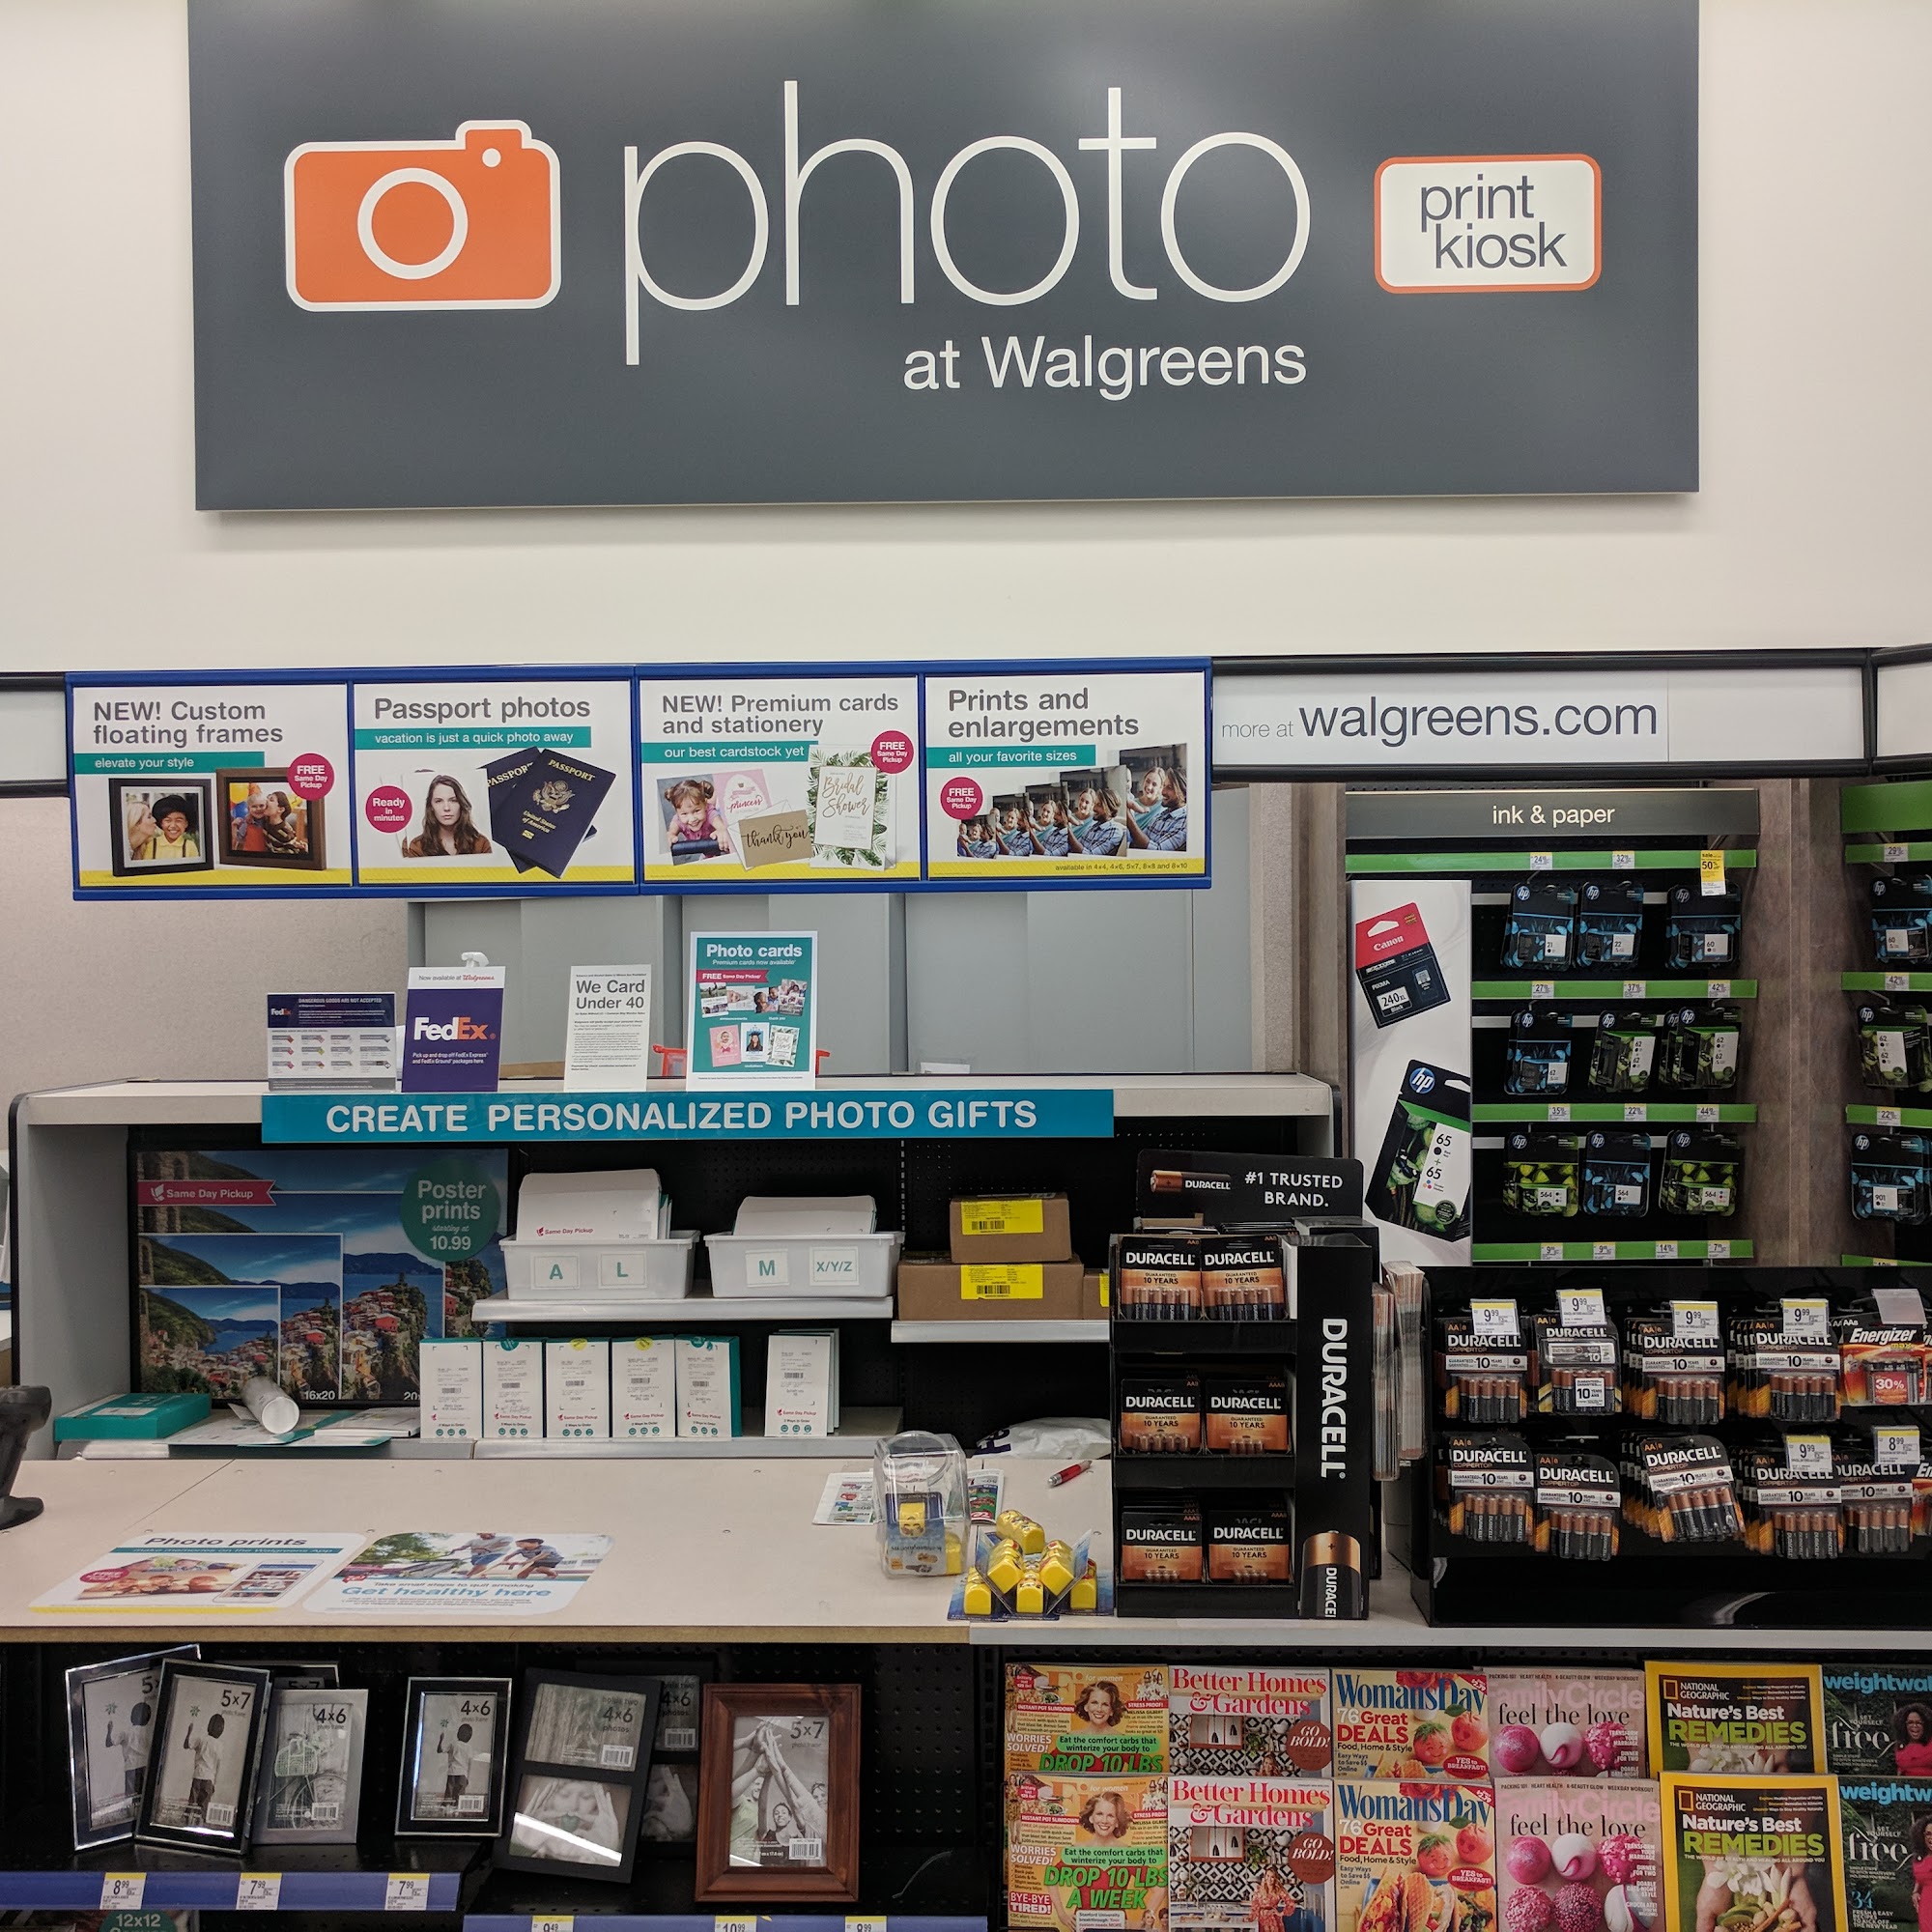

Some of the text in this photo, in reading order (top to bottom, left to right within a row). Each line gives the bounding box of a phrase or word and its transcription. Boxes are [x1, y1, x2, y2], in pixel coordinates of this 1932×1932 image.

[1419, 172, 1536, 233] print
[624, 79, 1312, 366] photo
[1434, 221, 1569, 270] kiosk
[903, 336, 1308, 401] at Walgreens
[662, 694, 898, 713] NEW! Premium cards
[950, 688, 1088, 711] Prints and
[95, 701, 265, 721] NEW! Custom
[375, 696, 590, 724] Passport photos
[663, 716, 823, 736] and stationery
[949, 715, 1139, 742] enlargements
[1222, 696, 1657, 748] more at walgreens.com
[94, 724, 283, 748] floating frames
[375, 732, 422, 743] vacation
[426, 732, 435, 742] is
[439, 732, 459, 744] just
[472, 731, 503, 744] quick
[507, 731, 540, 743] photo
[544, 732, 573, 743] away
[665, 746, 805, 759] our best cardstock yet
[949, 752, 1077, 764] all your favorite sizes
[95, 757, 194, 770] elevate your style
[298, 765, 325, 774] FREE
[548, 758, 596, 782] PASSPORT
[822, 772, 864, 798] Bridal
[372, 798, 405, 809] Ready
[822, 795, 870, 818] Shower
[1492, 805, 1615, 829] ink & paper
[707, 944, 802, 956] Photo cards
[1374, 935, 1404, 951] Canon
[577, 980, 645, 993] We Card
[576, 996, 644, 1009] Under 40
[413, 1017, 488, 1040] FedEx
[1410, 1068, 1434, 1094] hp
[326, 1099, 1037, 1133] CREATE PERSONALIZED PHOTO GIFTS
[1436, 1133, 1452, 1147] 65
[1426, 1166, 1442, 1179] 65
[1185, 1179, 1231, 1190] DURACELL
[1245, 1172, 1343, 1189] #1 TRUSTED
[166, 1189, 253, 1200] Same Day Pickup
[417, 1180, 486, 1200] Poster
[1264, 1192, 1328, 1208] BRAND.
[421, 1201, 481, 1223] prints
[432, 1223, 459, 1234] starting
[430, 1236, 471, 1251] 10.99
[1125, 1252, 1195, 1265] DURACELL
[1205, 1252, 1274, 1265] DURACELL
[549, 1264, 563, 1279] A
[616, 1263, 628, 1277] L
[758, 1261, 776, 1276] M
[816, 1262, 853, 1272] X/Y/Z
[1546, 1328, 1606, 1338] DURACELL
[1850, 1328, 1917, 1345] Energizer
[1449, 1335, 1520, 1347] DURACELL
[1875, 1378, 1904, 1389] 30%
[304, 1390, 335, 1401] 16x20
[1125, 1397, 1194, 1408] DURACELL
[1211, 1397, 1281, 1409] DURACELL
[1321, 1319, 1348, 1478] DURACELL
[1453, 1450, 1526, 1463] DURACELL
[1540, 1468, 1613, 1483] DURACELL
[1126, 1529, 1195, 1541] DURACELL
[1213, 1527, 1283, 1539] DURACELL
[145, 1537, 222, 1546] Photo
[393, 1588, 488, 1598] healthy
[1174, 1669, 1326, 1694] Better Homes
[1681, 1690, 1729, 1700] GEOGRAPHIC
[1190, 1691, 1311, 1717] & Gardens
[1667, 1703, 1784, 1719] Nature's Best
[1337, 1708, 1408, 1725] 76 Great
[1498, 1702, 1630, 1726] feel the love
[1300, 1725, 1320, 1737] GO
[1338, 1724, 1408, 1744] DEALS
[1668, 1719, 1806, 1743] REMEDIES
[1290, 1736, 1330, 1748] BOLD!
[1010, 1844, 1056, 1857] WORRIES
[1010, 1855, 1053, 1865] SOLVED!
[1127, 1857, 1147, 1865] body
[1044, 1866, 1168, 1888] DROP 10 LBS
[1010, 1892, 1050, 1904] BYE-BYE
[1066, 1889, 1148, 1909] A WEEK
[1010, 1903, 1051, 1914] TIRED!
